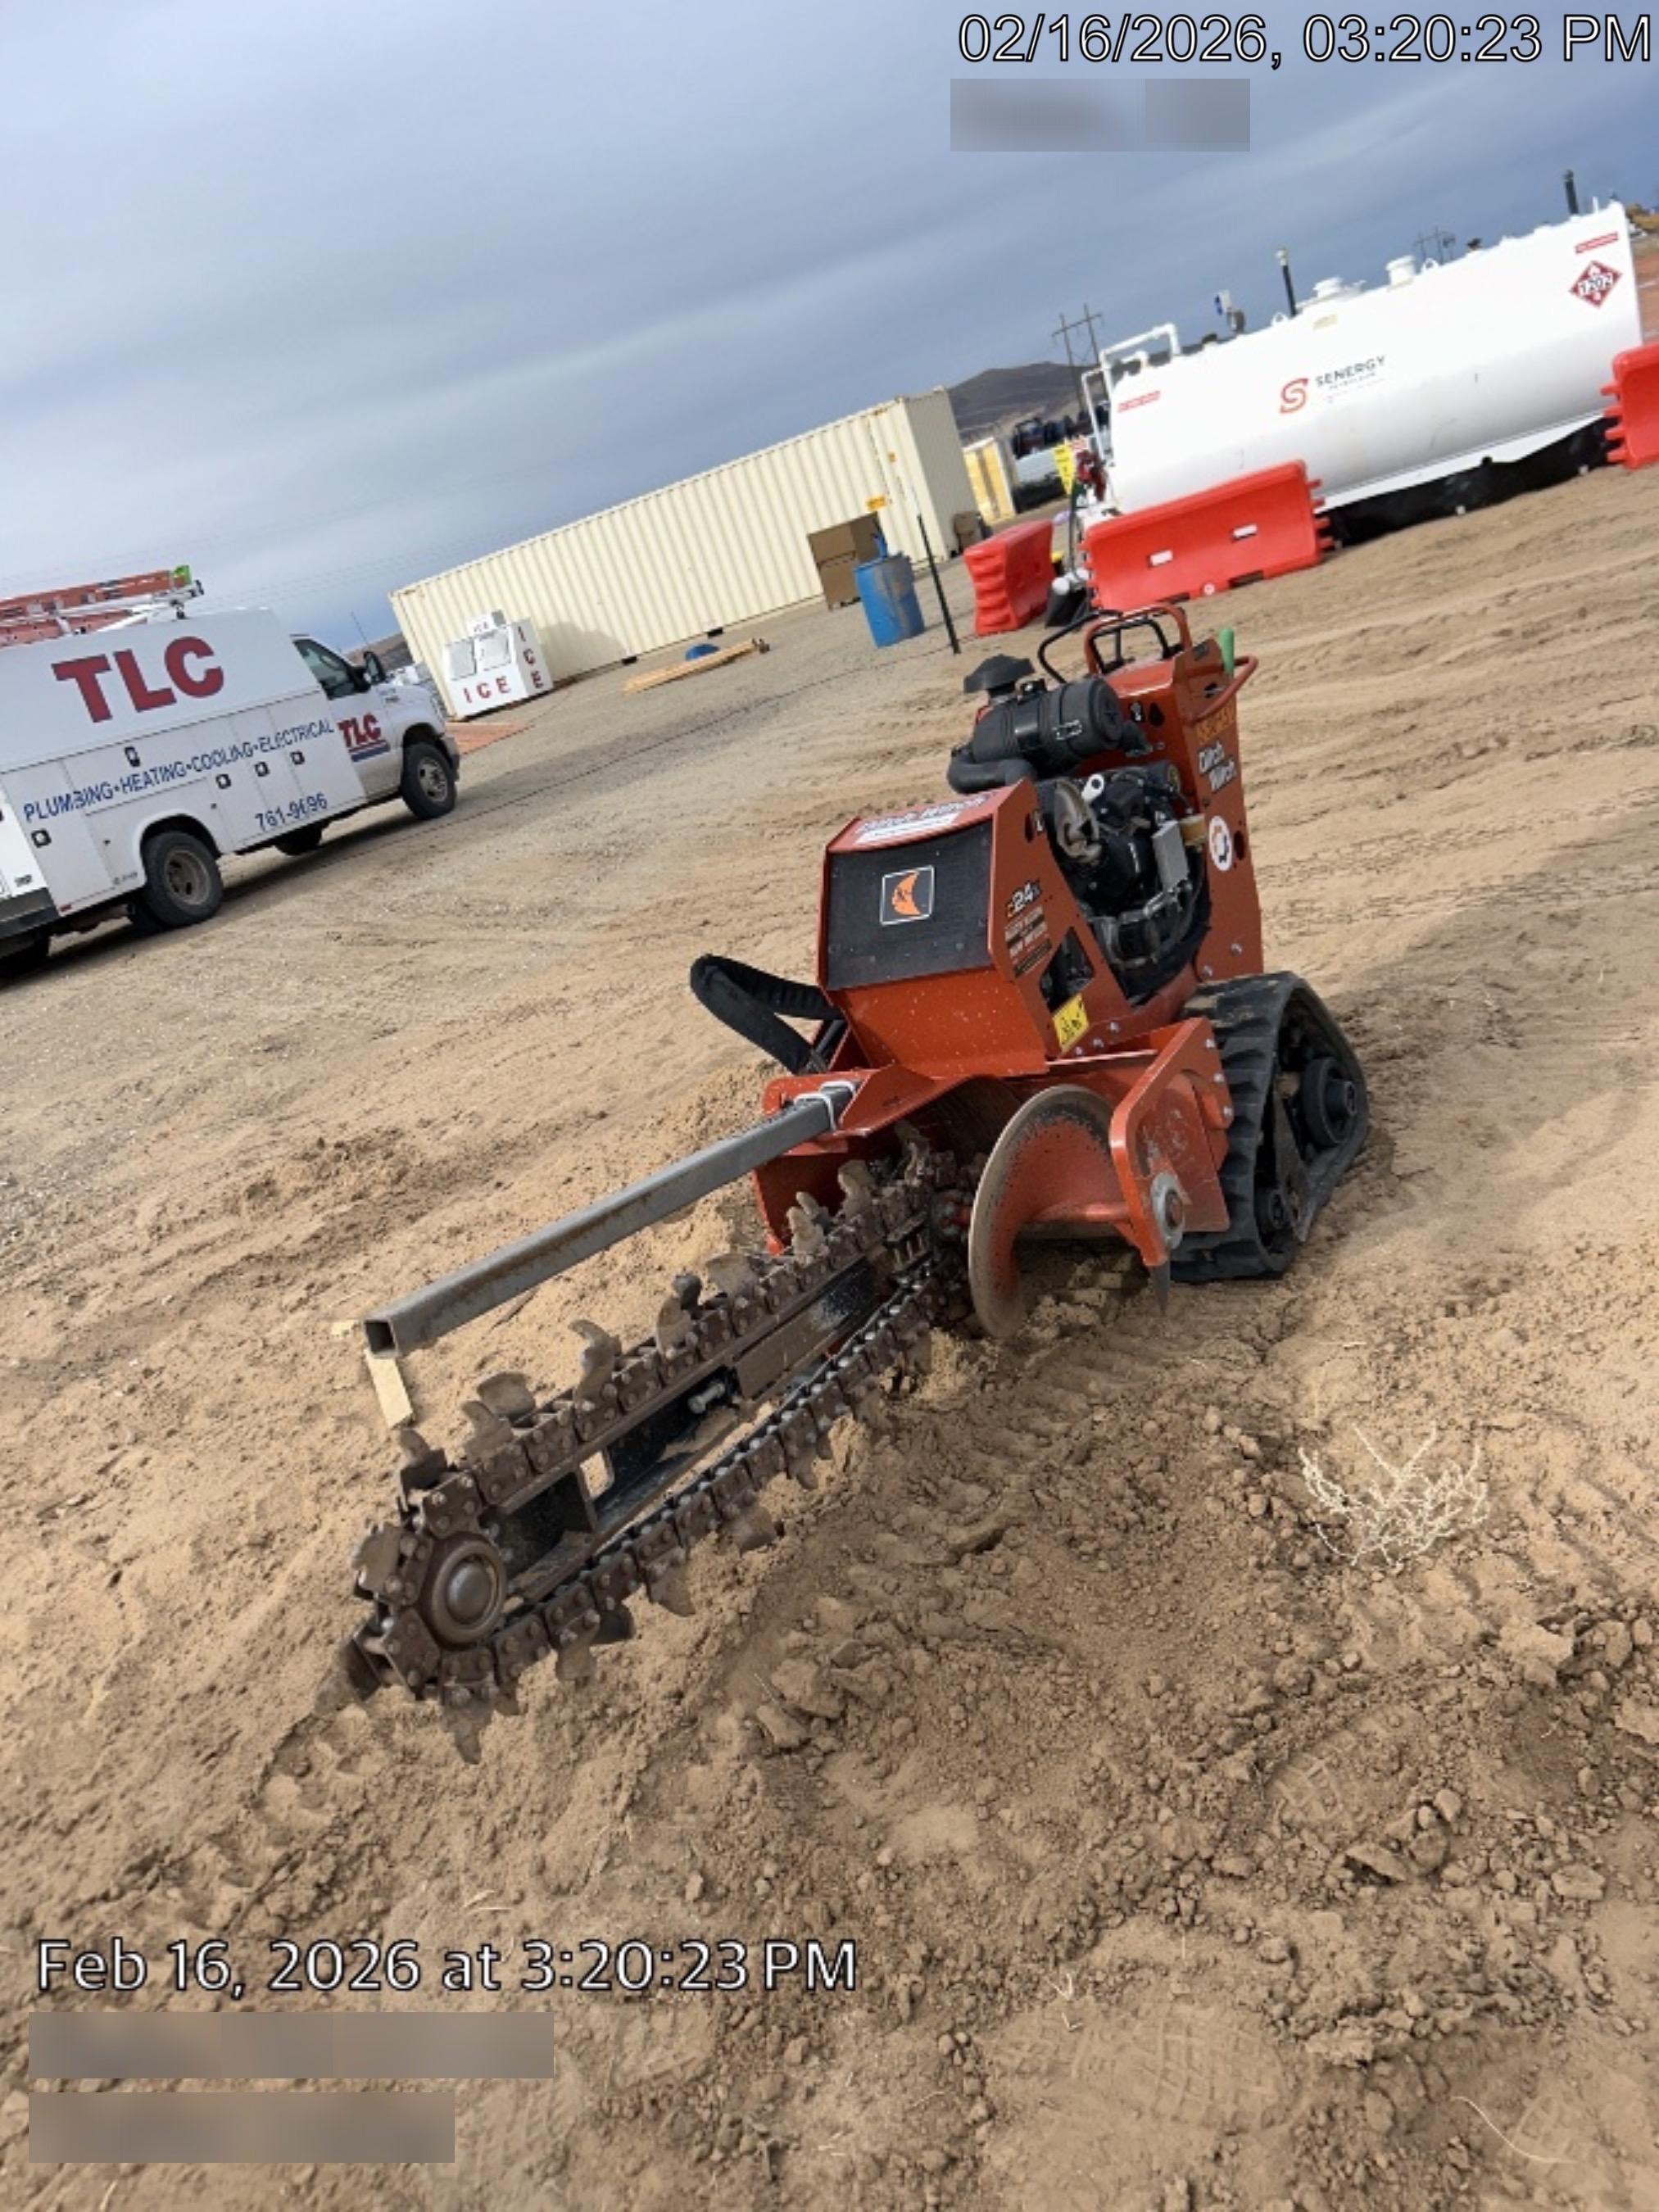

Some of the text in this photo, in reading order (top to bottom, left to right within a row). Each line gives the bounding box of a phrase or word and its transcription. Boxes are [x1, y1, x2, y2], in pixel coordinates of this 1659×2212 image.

[51, 636, 224, 723] TLC
[463, 675, 511, 704] ICE
[337, 712, 382, 748] TLC
